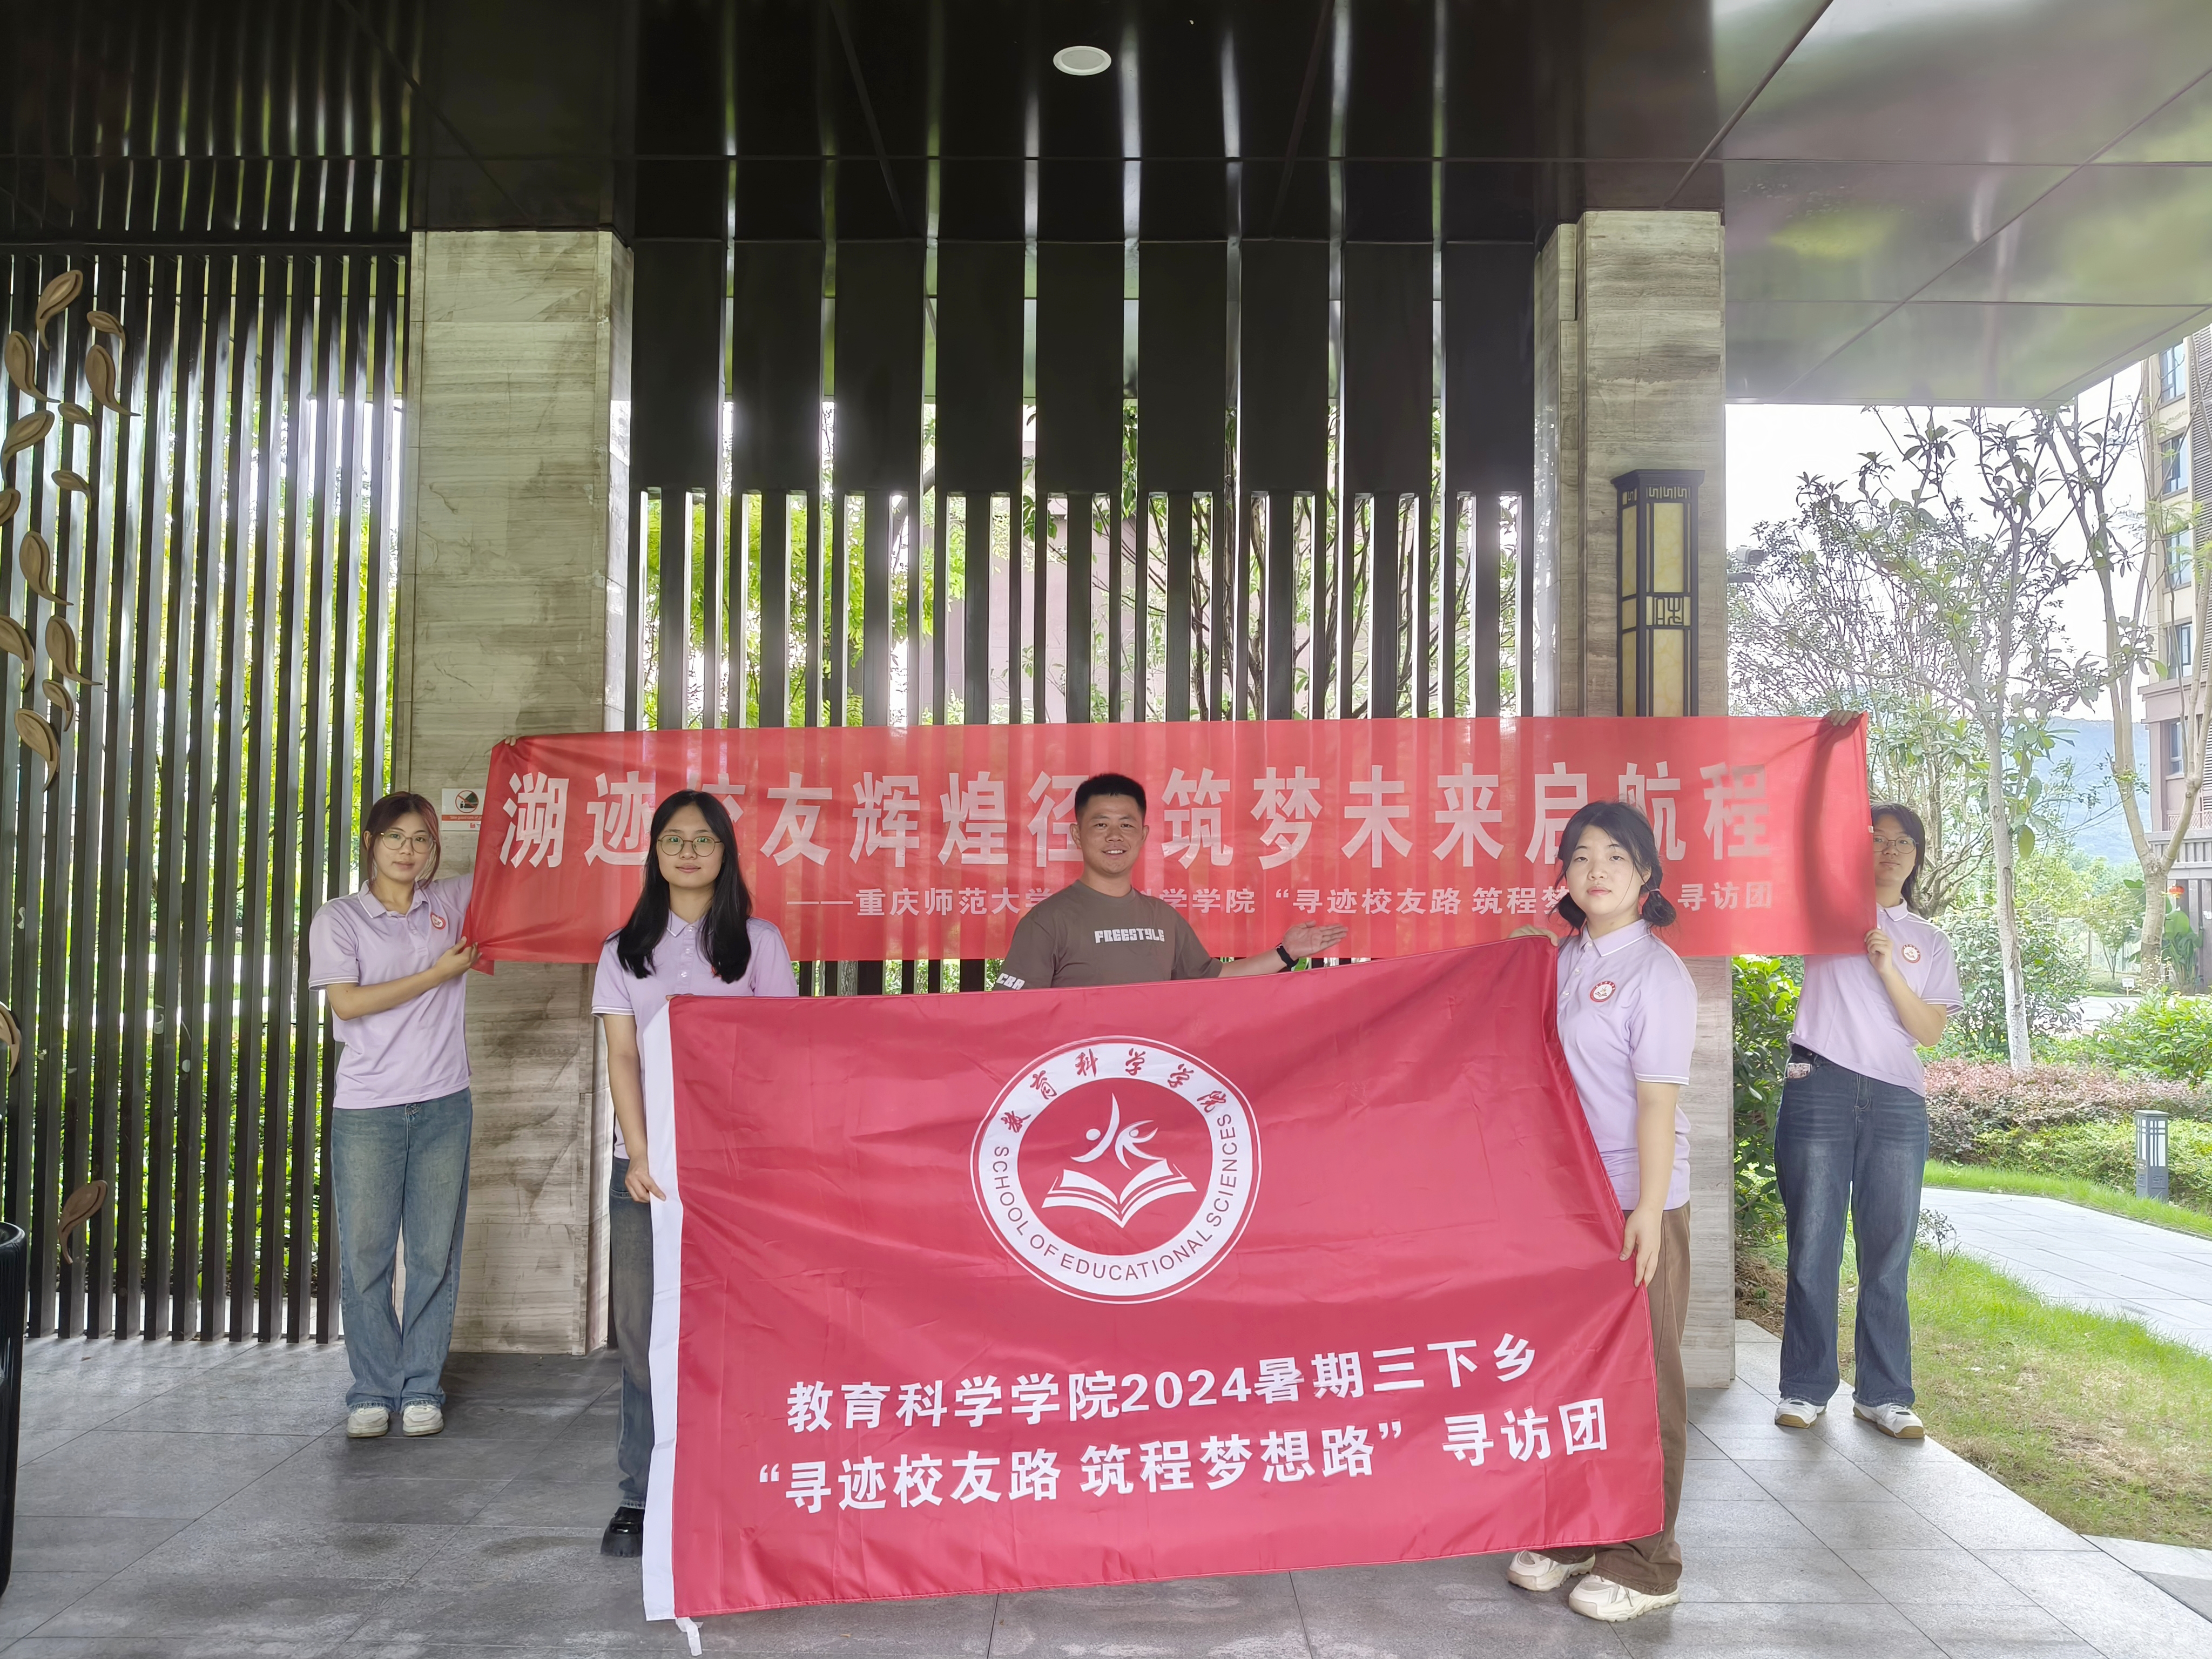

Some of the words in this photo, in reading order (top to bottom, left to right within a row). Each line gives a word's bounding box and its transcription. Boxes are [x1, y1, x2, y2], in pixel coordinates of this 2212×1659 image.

[1161, 761, 1771, 869] 筑梦未来启航程
[1094, 928, 1165, 943] FREESTYLE
[996, 973, 1025, 990] CBA
[1001, 1048, 1226, 1132] 教育科学学院
[992, 1145, 1029, 1236] SCHOOL
[1029, 1233, 1059, 1257] OF
[1060, 1230, 1213, 1281] EDUCATIONAL
[1205, 1113, 1238, 1227] SCIENCES
[787, 1333, 1536, 1433] 教育科学学院2024暑期三下乡
[1442, 1398, 1607, 1466] 寻访团
